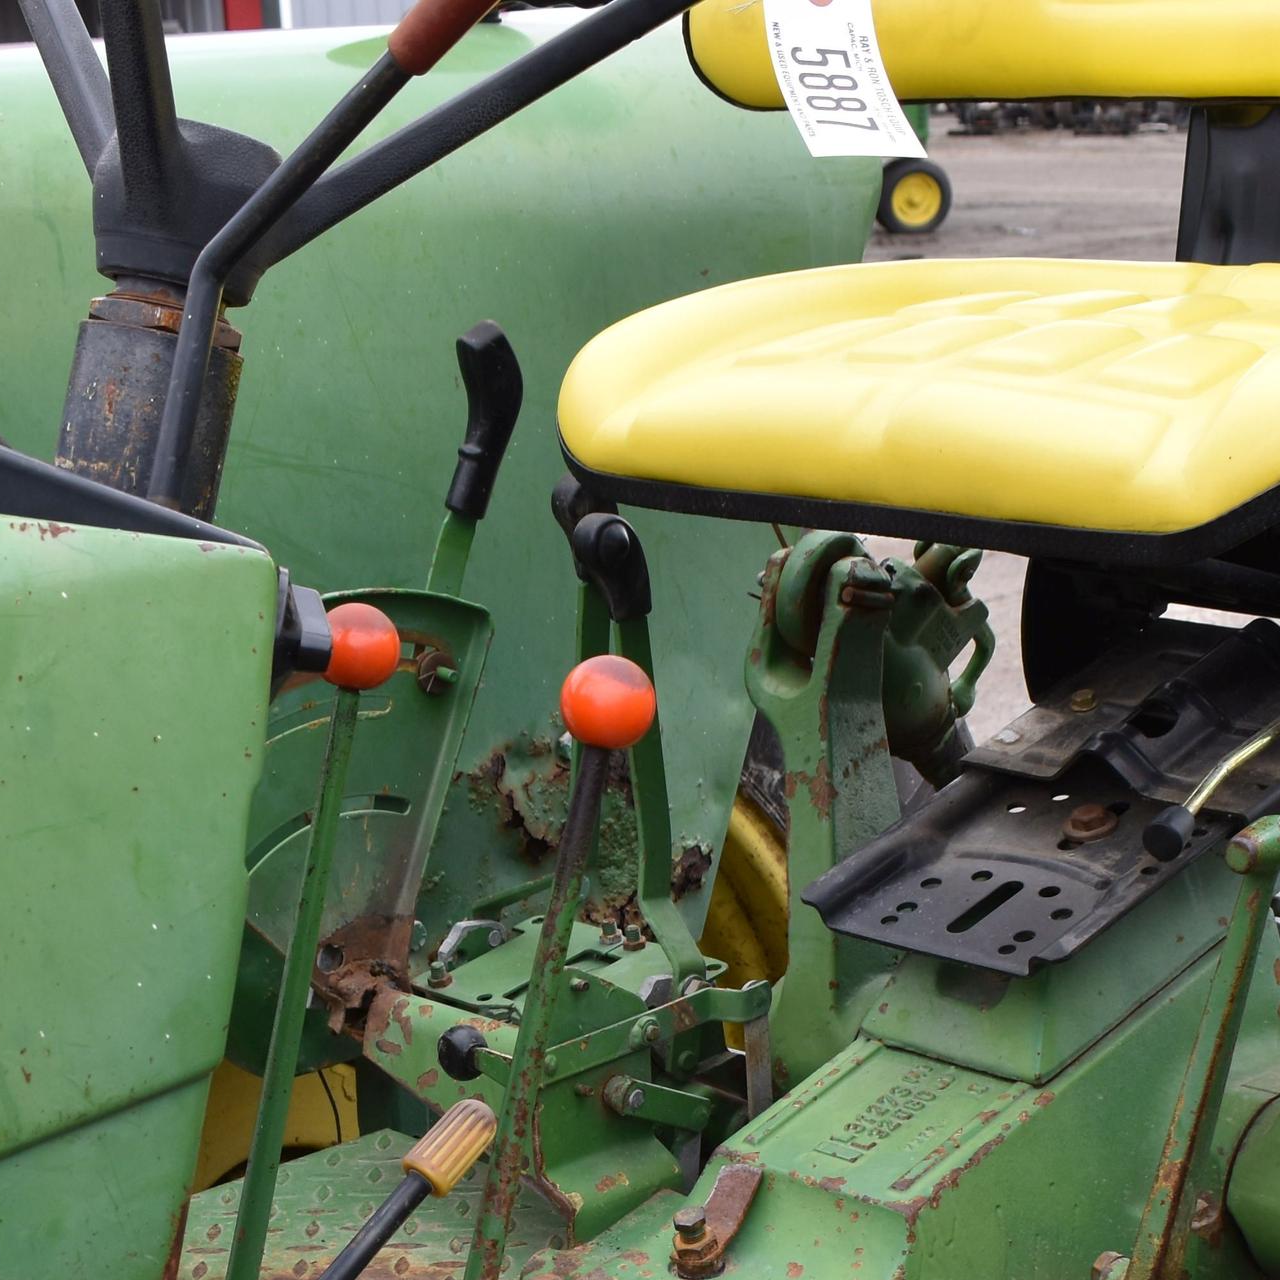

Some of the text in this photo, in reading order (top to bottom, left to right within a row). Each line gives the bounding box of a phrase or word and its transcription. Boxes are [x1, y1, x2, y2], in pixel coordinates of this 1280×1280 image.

[772, 21, 781, 39] NEW
[777, 50, 788, 70] USED
[859, 35, 871, 54] RAY
[867, 67, 881, 84] RON
[790, 46, 880, 131] 5887
